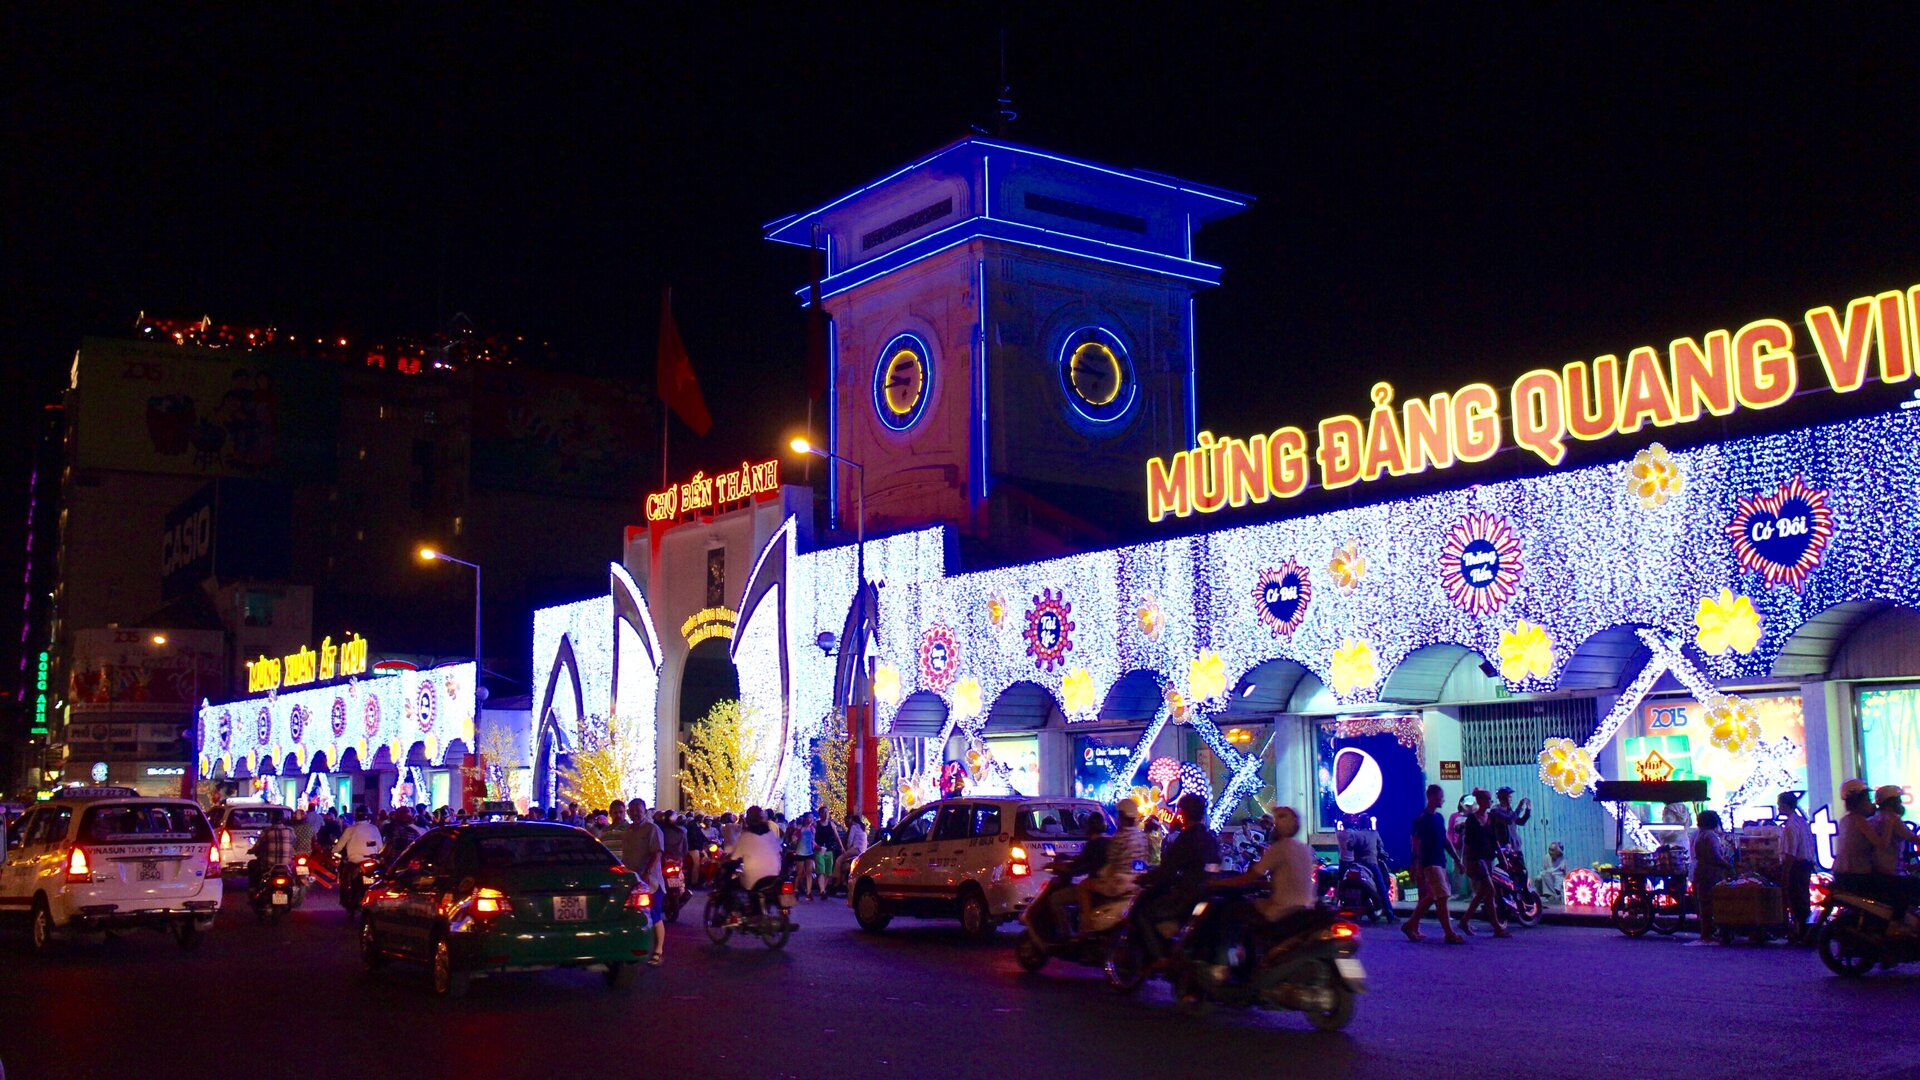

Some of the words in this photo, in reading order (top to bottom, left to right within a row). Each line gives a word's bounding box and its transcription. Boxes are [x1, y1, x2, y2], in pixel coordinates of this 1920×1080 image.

[1146, 430, 1309, 523] MỪNG
[1317, 381, 1501, 491] ĐẢNG
[1511, 318, 1797, 467] QUANG
[1804, 284, 1920, 394] VI
[646, 484, 677, 520] CHỢ
[681, 471, 713, 513] BẾN
[716, 460, 778, 503] THÀNH
[161, 504, 210, 576] CASIO
[1751, 520, 1775, 542] Có
[1776, 515, 1809, 538] Đôi
[36, 651, 49, 691] SONG
[249, 655, 281, 693] MỪNG
[284, 645, 316, 687] XUÂN
[35, 693, 47, 723] ANH
[1650, 707, 1688, 728] 2015
[557, 908, 585, 920] 2040
